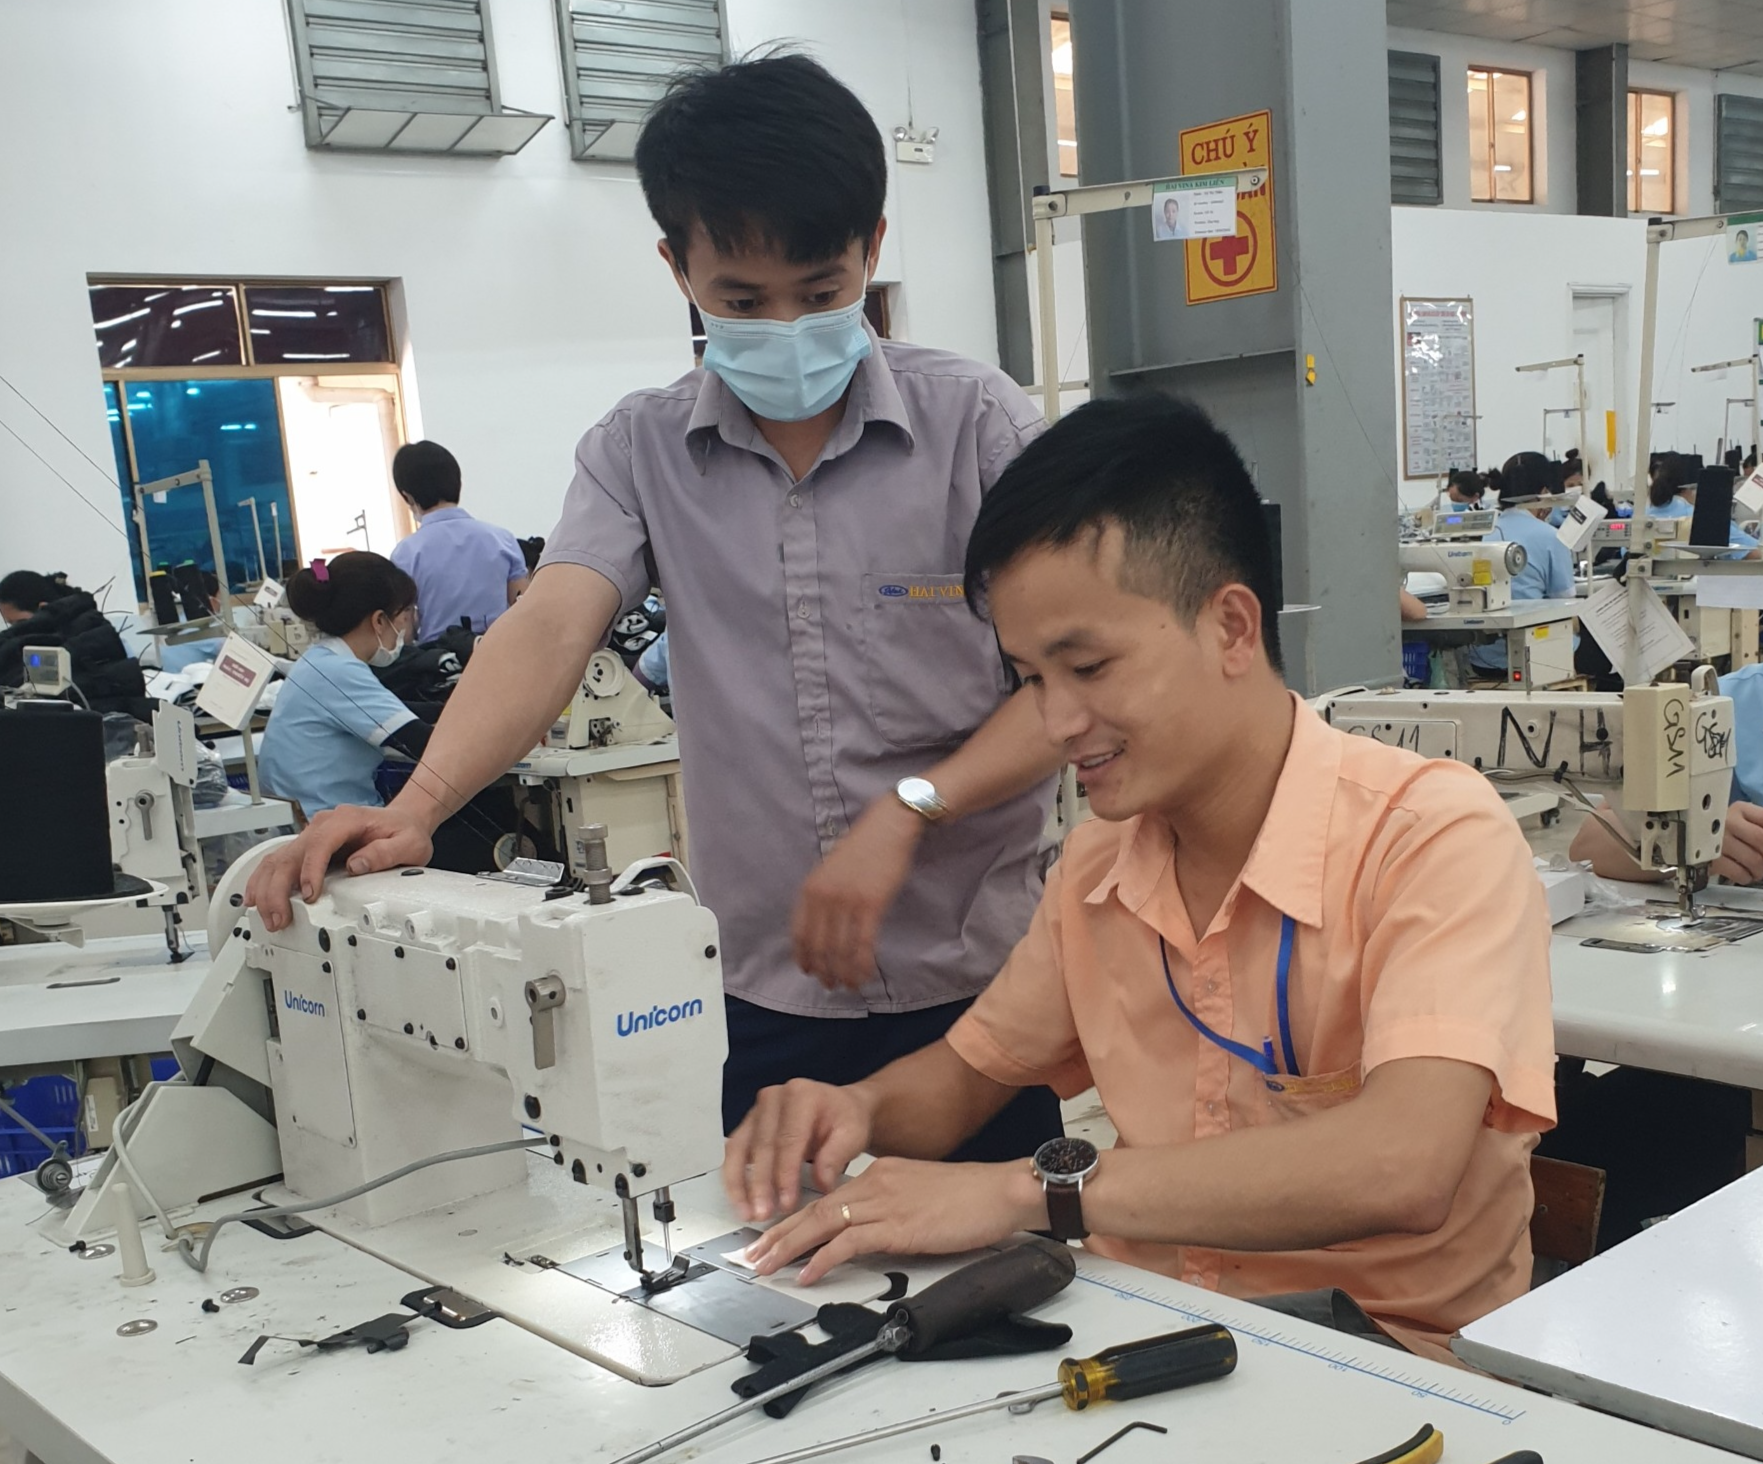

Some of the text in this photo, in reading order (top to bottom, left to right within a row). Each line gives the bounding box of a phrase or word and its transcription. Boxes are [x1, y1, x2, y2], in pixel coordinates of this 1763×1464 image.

[1191, 122, 1260, 166] CHÚ Ý
[909, 585, 935, 599] HAI
[939, 585, 965, 598] VIN
[284, 990, 326, 1018] Unicorn
[616, 998, 703, 1037] Unicorn
